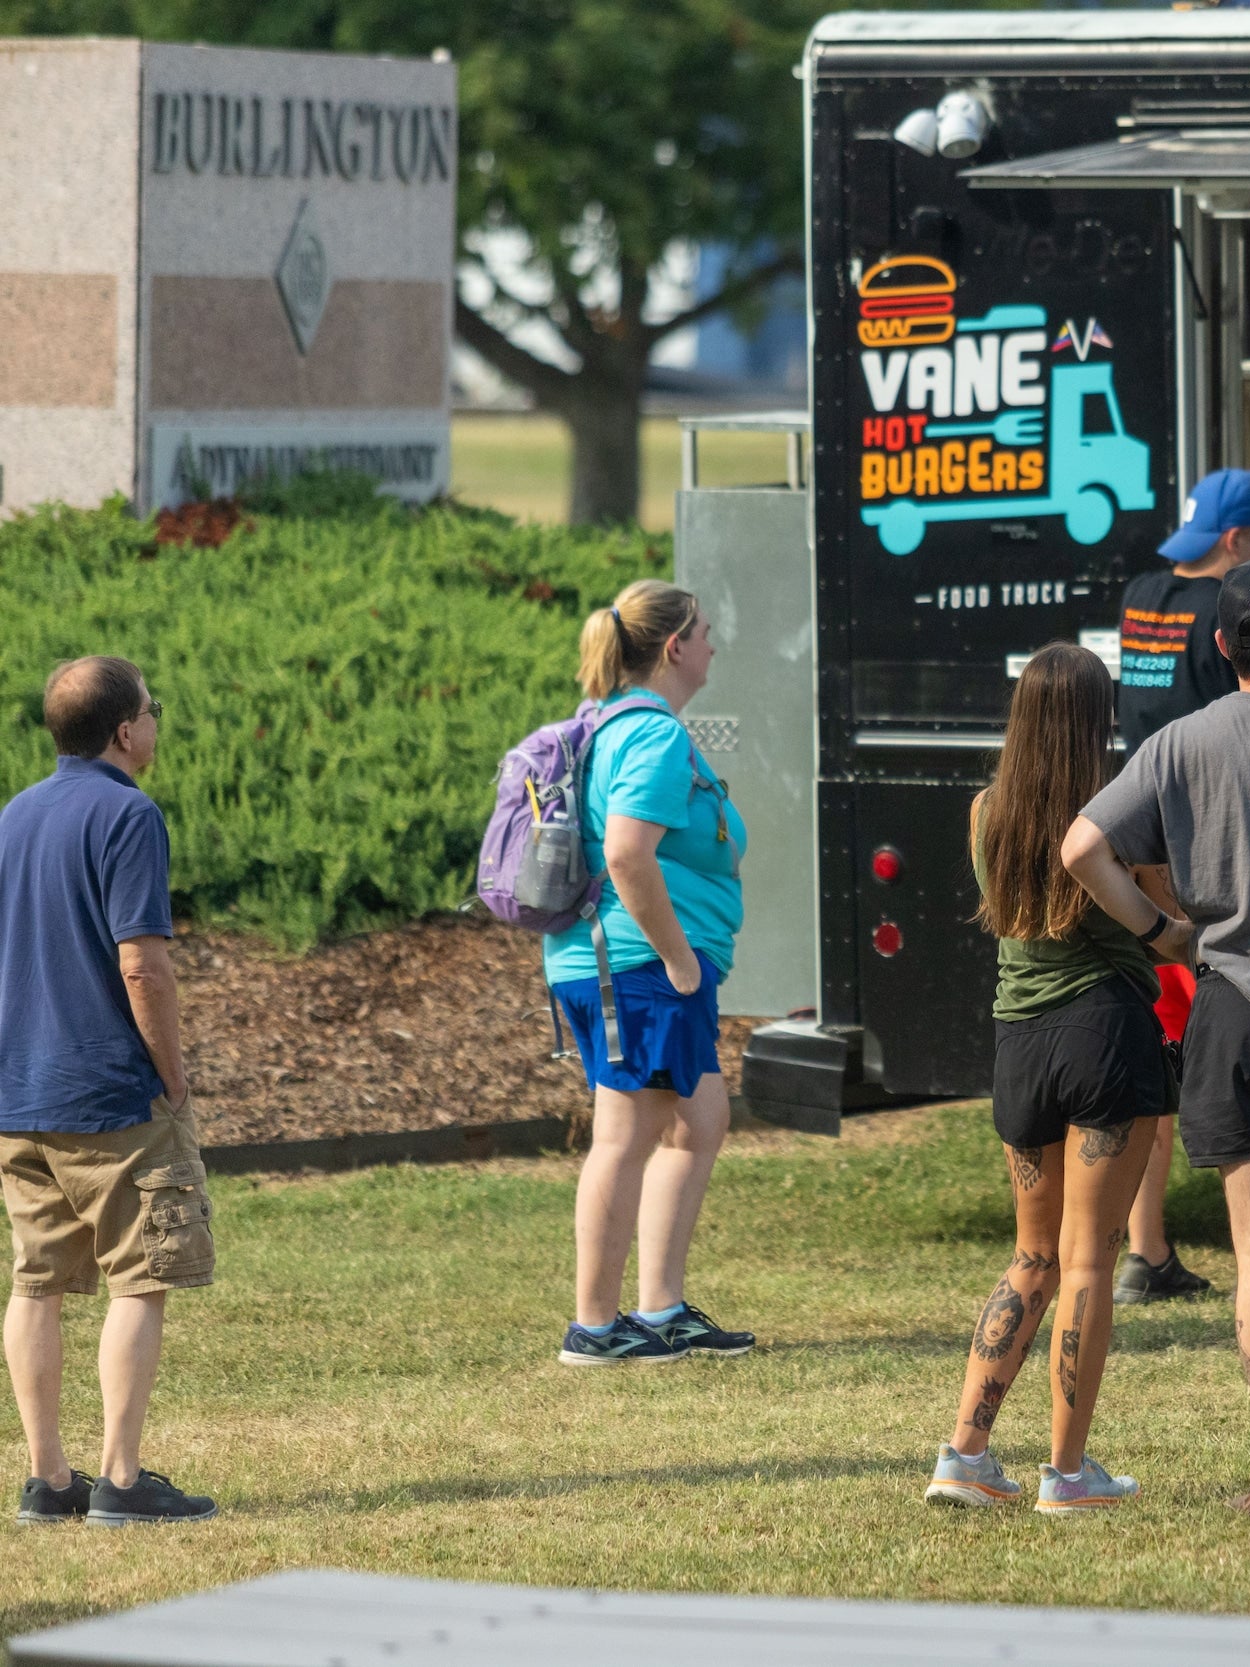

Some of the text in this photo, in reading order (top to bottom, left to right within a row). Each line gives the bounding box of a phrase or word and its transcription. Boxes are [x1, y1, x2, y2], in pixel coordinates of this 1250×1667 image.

[152, 92, 451, 183] BURLINGTON
[861, 332, 1047, 417] VANE
[863, 415, 927, 450] HOT
[861, 440, 1044, 498] BURGERS
[938, 582, 1066, 609] FOOD TRUCK
